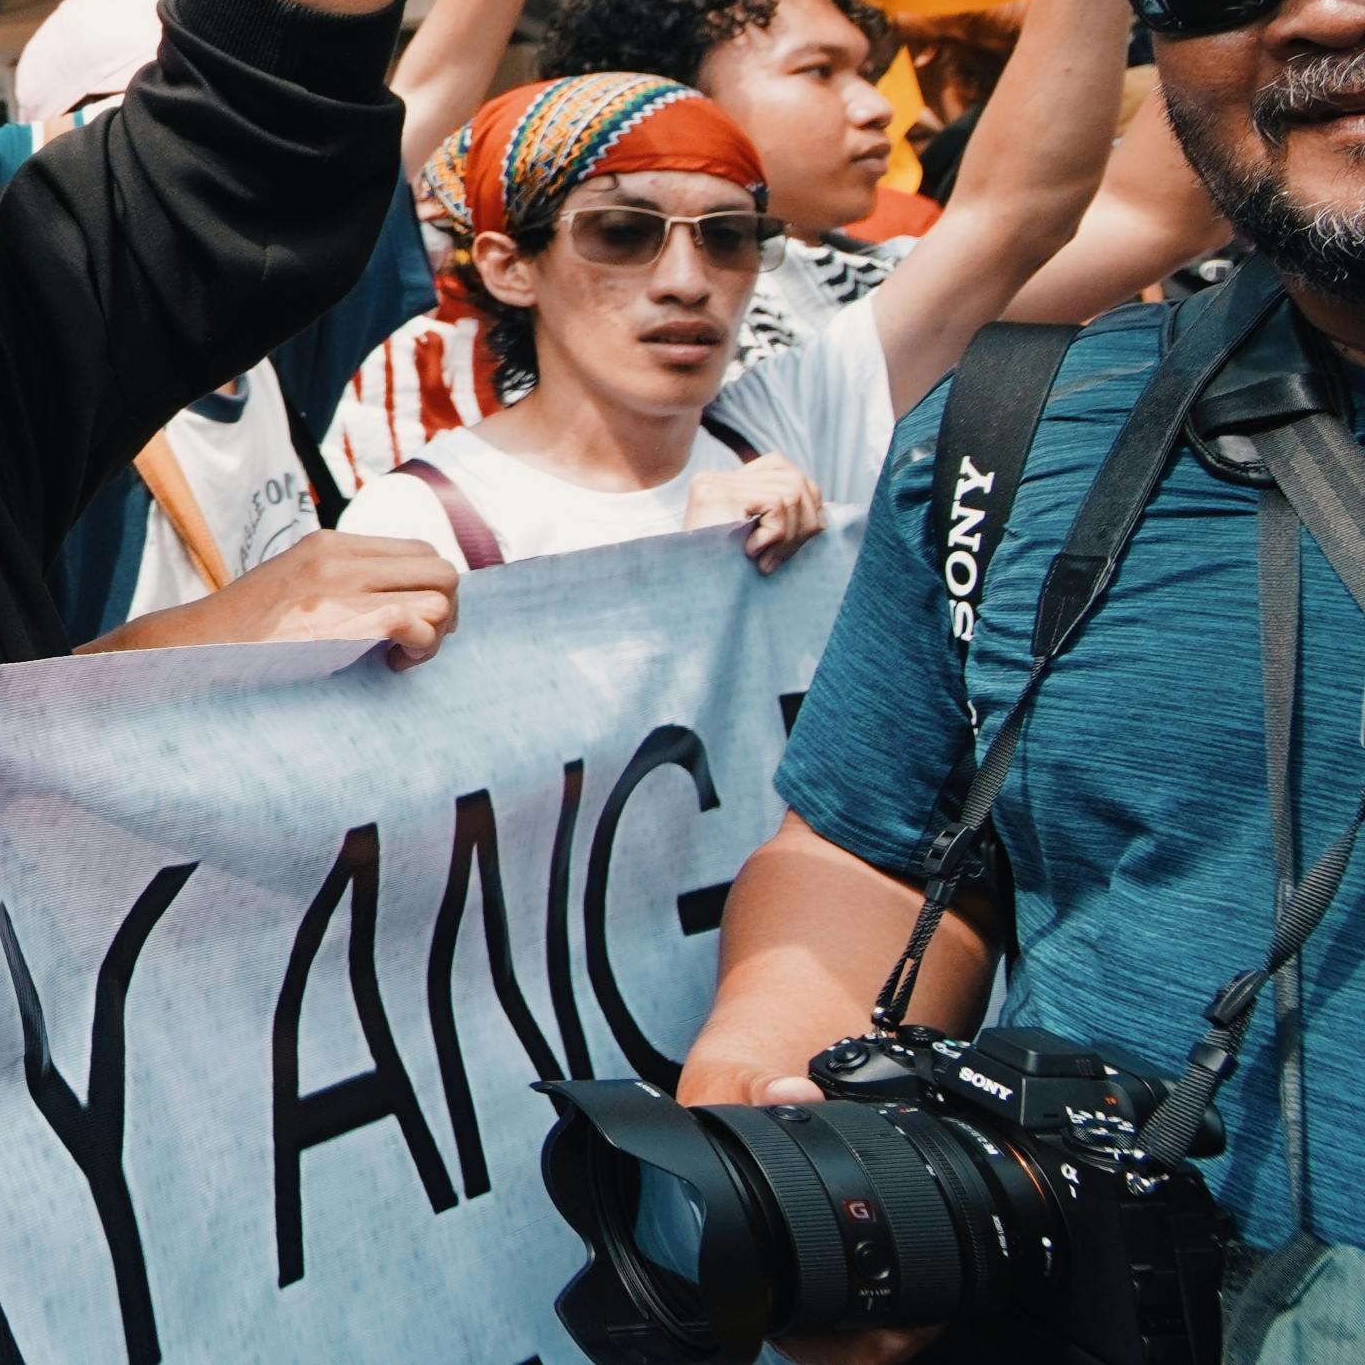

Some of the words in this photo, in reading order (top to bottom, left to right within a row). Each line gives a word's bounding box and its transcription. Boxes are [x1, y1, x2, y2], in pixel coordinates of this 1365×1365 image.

[945, 455, 995, 642] SONY
[272, 723, 734, 1289] ANG
[958, 1066, 1014, 1102] SONY
